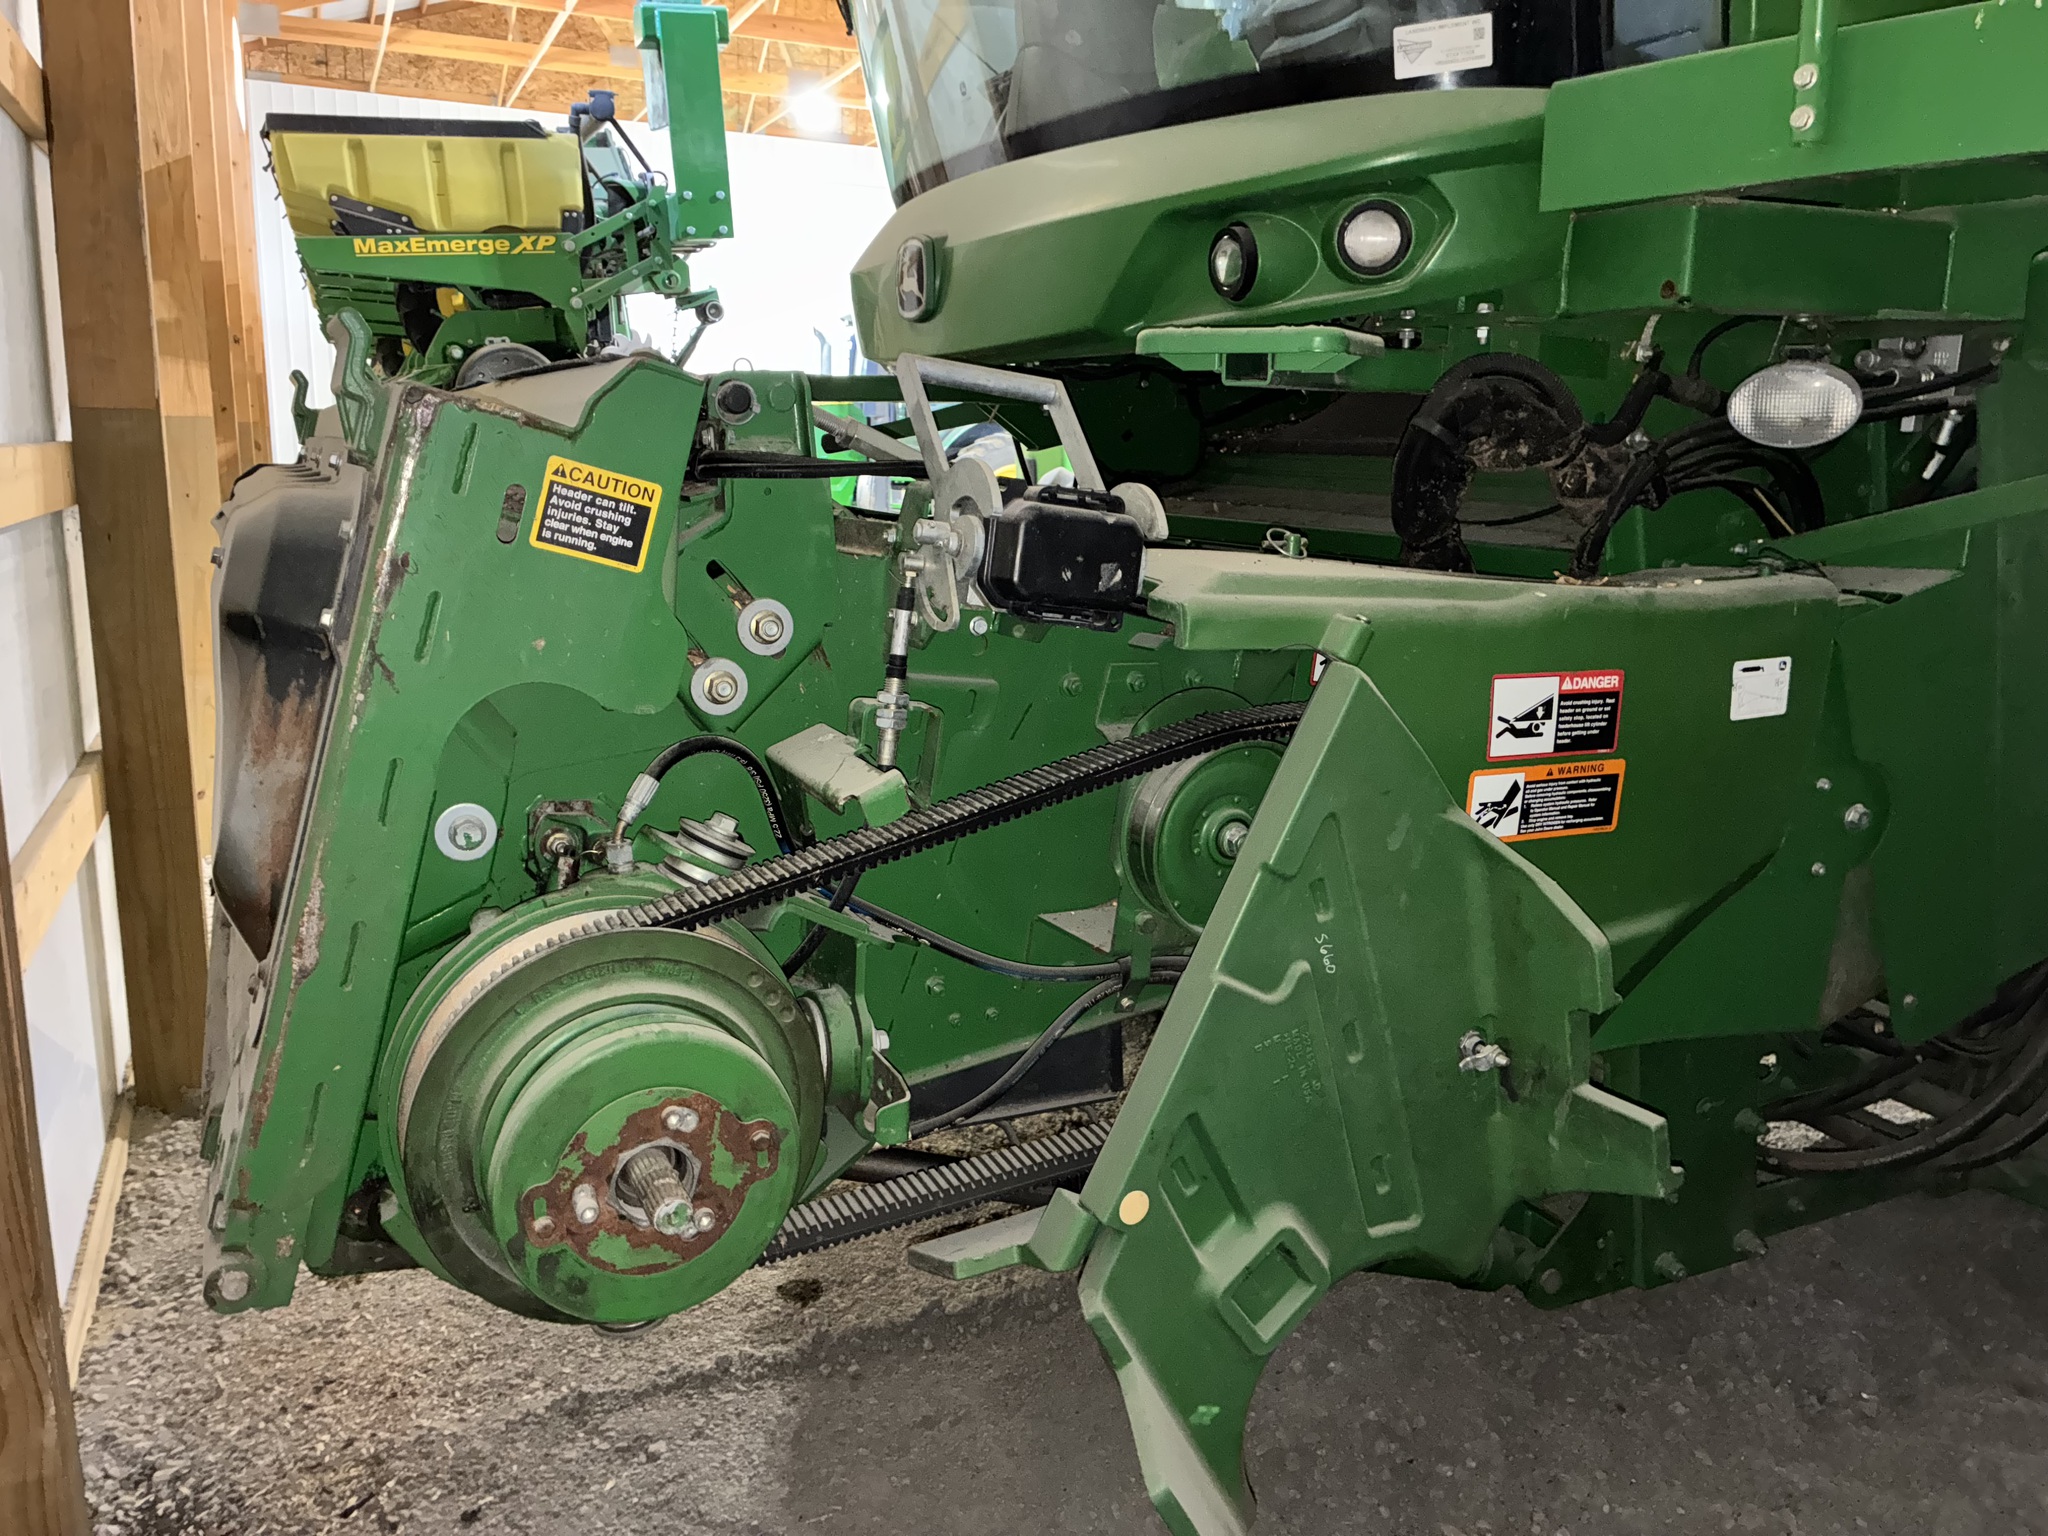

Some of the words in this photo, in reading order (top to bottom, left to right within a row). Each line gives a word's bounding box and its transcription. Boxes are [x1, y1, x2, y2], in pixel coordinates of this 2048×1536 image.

[353, 237, 510, 256] MaxEmerge
[510, 236, 556, 254] XP
[569, 466, 655, 502] CAUTION
[550, 495, 582, 511] Avoid
[584, 505, 632, 526] crushing
[552, 483, 593, 502] Header
[595, 496, 616, 509] can
[619, 502, 637, 514] tilt.
[544, 518, 570, 531] clear
[571, 525, 598, 539] when
[600, 533, 634, 548] engine
[547, 506, 592, 526] injuries.
[594, 519, 620, 534] Stay
[542, 528, 552, 538] is
[554, 532, 597, 551] running.
[1572, 676, 1619, 690] DANGER
[1558, 764, 1605, 775] WARNING
